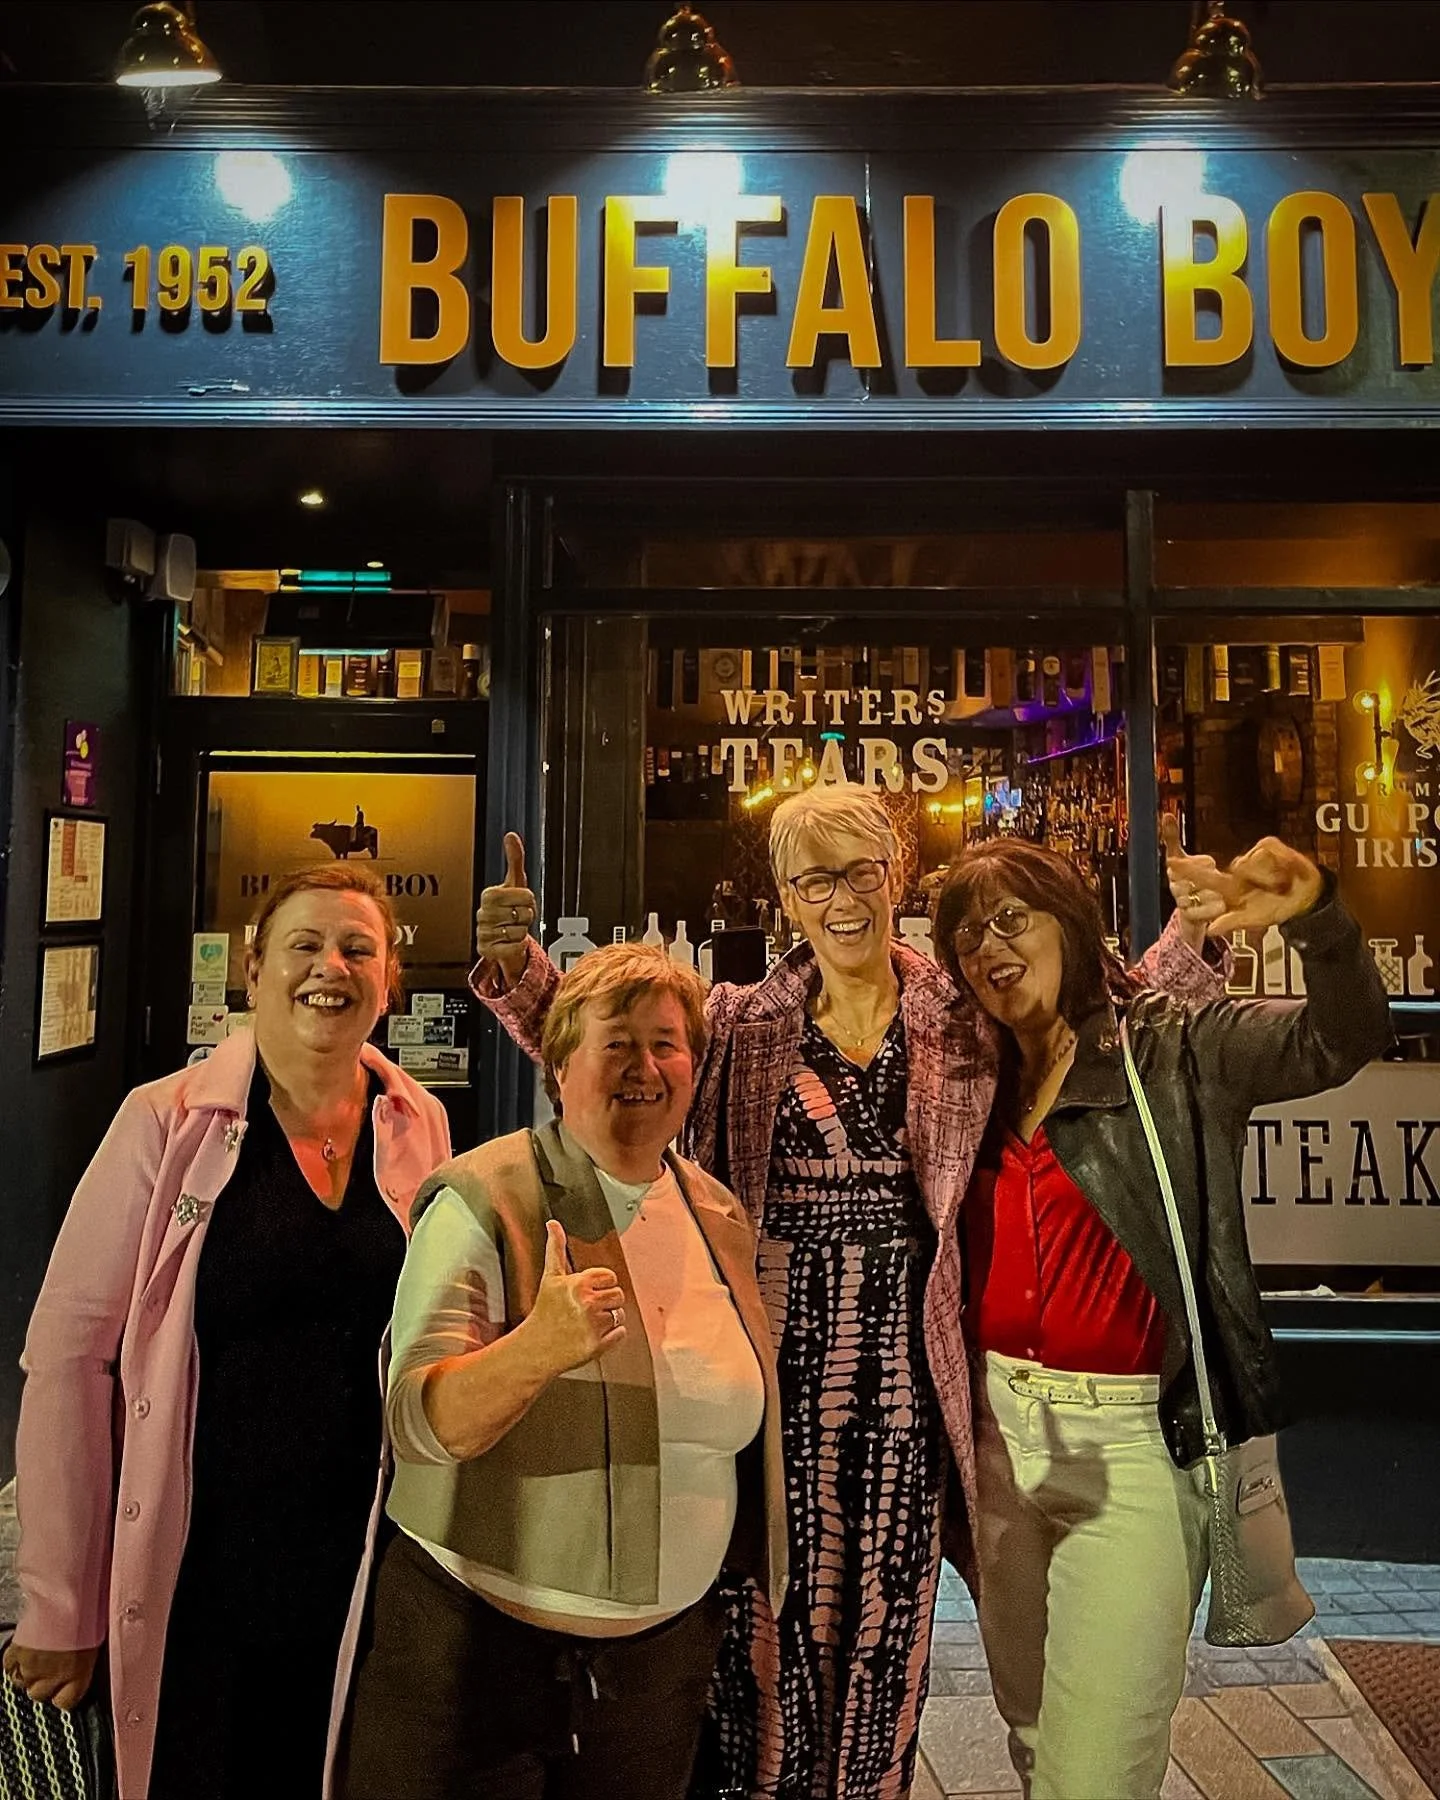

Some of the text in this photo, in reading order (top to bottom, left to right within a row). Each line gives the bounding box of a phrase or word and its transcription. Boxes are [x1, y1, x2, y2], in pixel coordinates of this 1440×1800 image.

[0, 244, 269, 313] EST. 1952
[379, 190, 1440, 370] BUFFALO BOY
[720, 689, 946, 725] WRITERS
[720, 738, 949, 793] TEARS
[1355, 838, 1438, 868] IRIS
[385, 874, 443, 897] BOY
